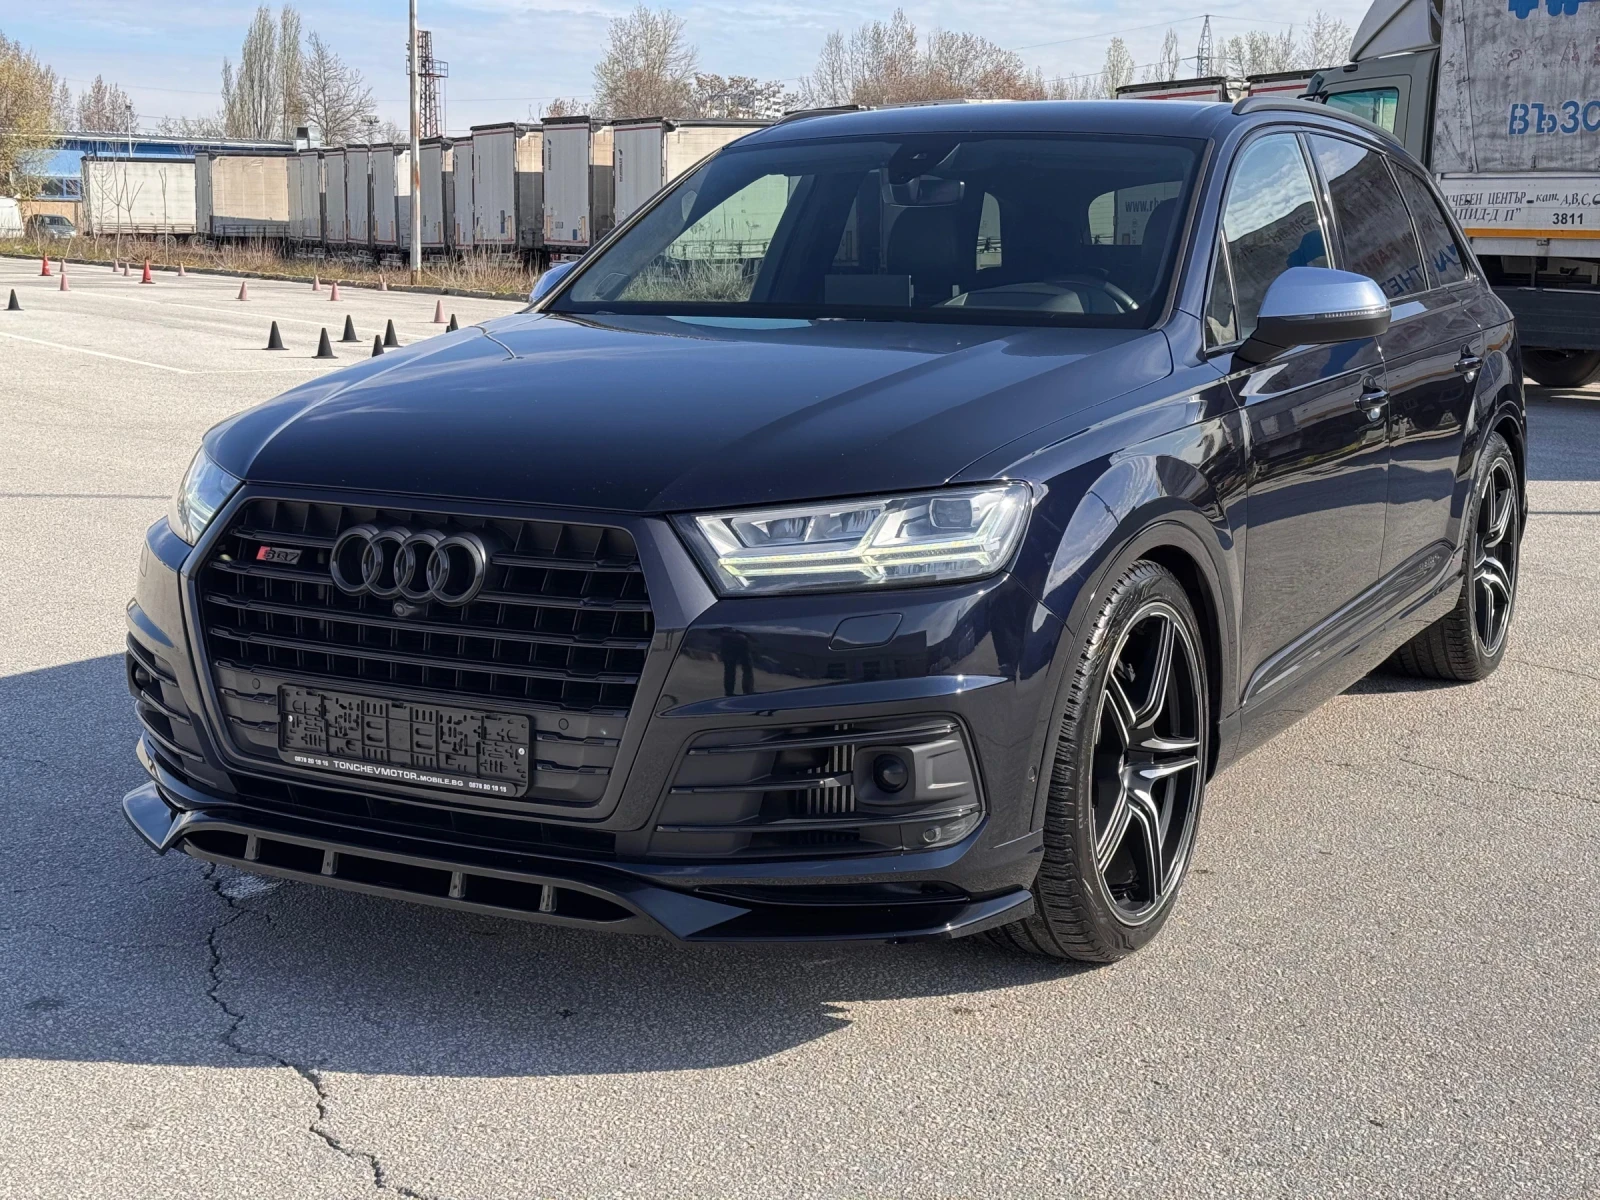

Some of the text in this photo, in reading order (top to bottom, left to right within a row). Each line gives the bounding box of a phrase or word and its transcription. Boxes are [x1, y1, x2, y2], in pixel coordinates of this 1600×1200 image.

[1487, 191, 1526, 207] ЦЕНТЪР
[1536, 193, 1559, 202] кат.
[1552, 212, 1584, 225] 3811
[263, 548, 300, 562] SQ7
[333, 760, 464, 787] TONCHEVMOTOR.MOBILE.BG
